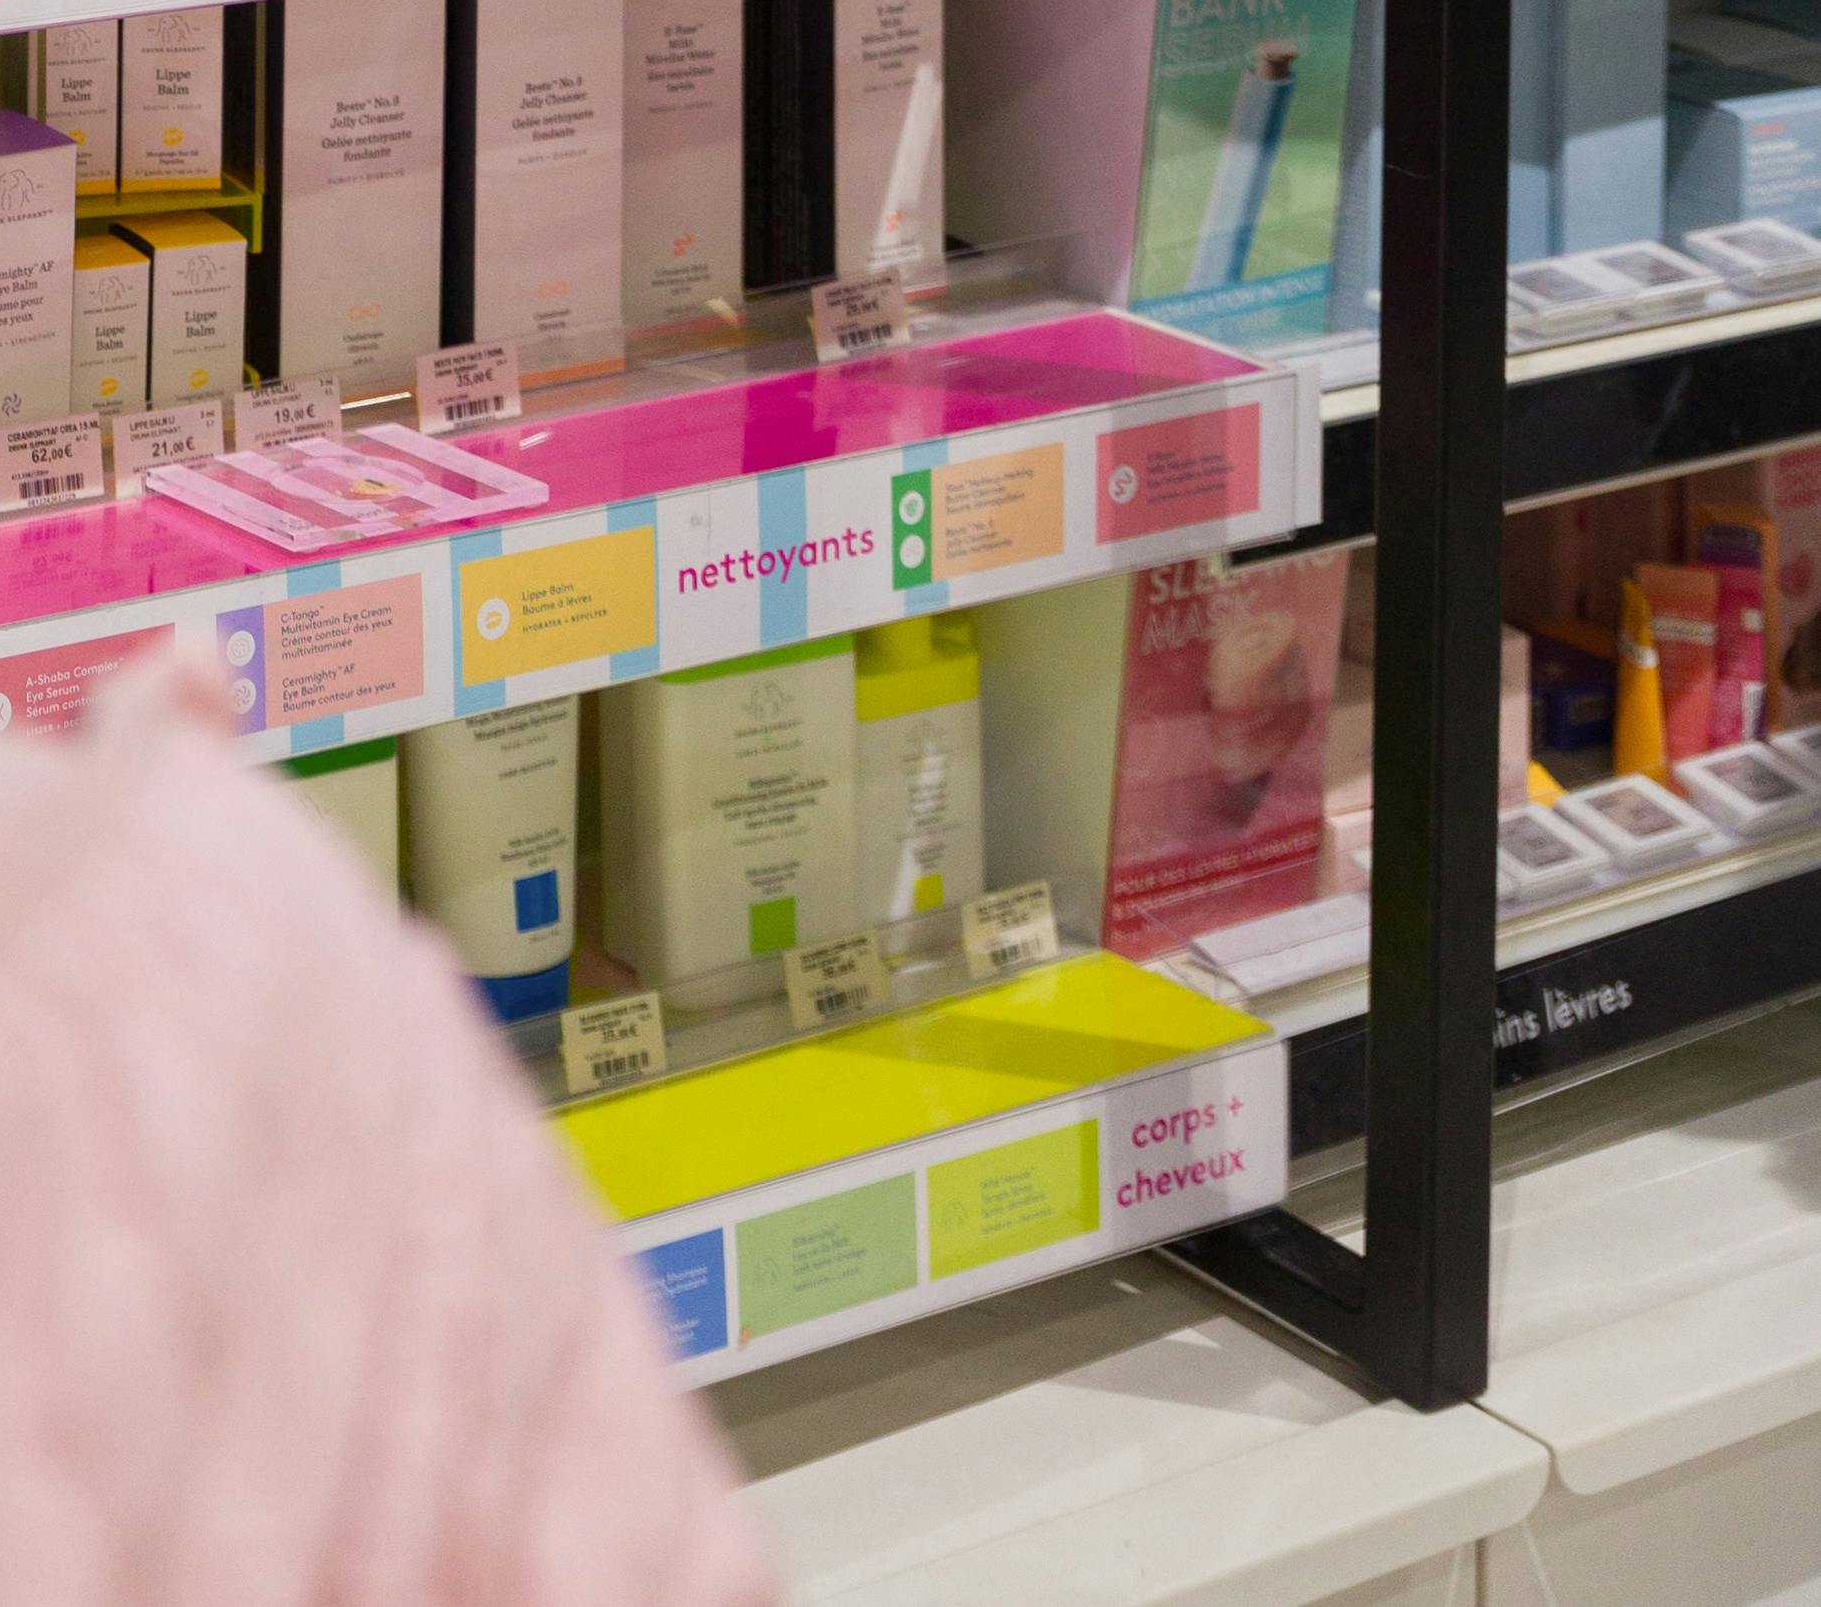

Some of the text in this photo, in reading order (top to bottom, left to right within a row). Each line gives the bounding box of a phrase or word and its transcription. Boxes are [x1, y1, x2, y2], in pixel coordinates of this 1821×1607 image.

[39, 260, 54, 273] AF
[12, 280, 38, 293] Balm
[20, 295, 44, 310] pour
[10, 312, 33, 326] yeux
[185, 309, 217, 323] Lippe
[186, 323, 215, 338] Balm
[678, 527, 875, 594] nettoyants
[522, 581, 574, 604] Lippe Balm
[281, 605, 392, 636] Multivitamin Eye Cream
[1494, 979, 1633, 1052] ins lèvres
[1130, 1094, 1245, 1151] corps +
[1116, 1145, 1247, 1209] cheveux
